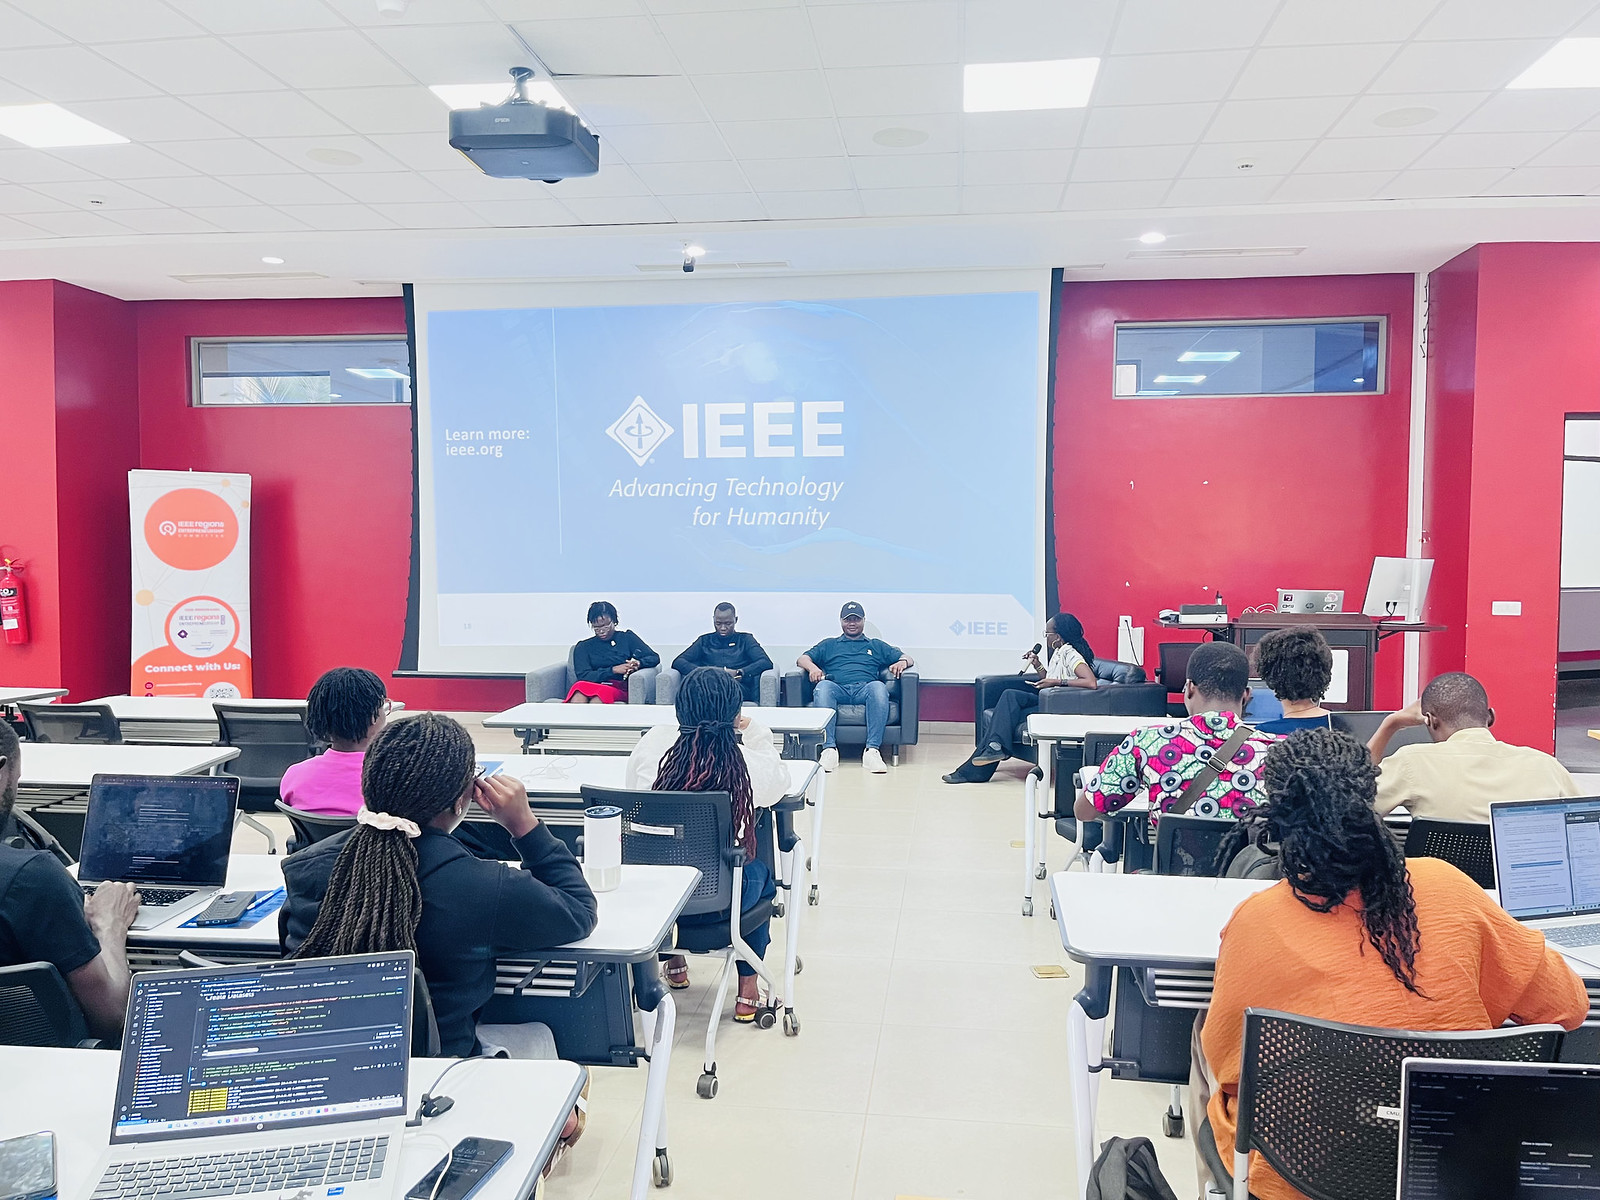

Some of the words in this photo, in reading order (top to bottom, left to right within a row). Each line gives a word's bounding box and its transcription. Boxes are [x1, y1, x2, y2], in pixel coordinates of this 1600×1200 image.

[445, 428, 484, 441] Learn
[488, 429, 530, 440] more:
[682, 401, 845, 459] IEEE
[445, 443, 503, 458] ieee.org
[608, 477, 718, 502] Advancing
[726, 476, 844, 501] Technology
[692, 506, 721, 526] for
[727, 506, 831, 530] Humanity
[967, 621, 1008, 635] IEEE
[144, 663, 193, 673] Connect
[195, 662, 221, 671] with
[223, 662, 241, 671] Us:
